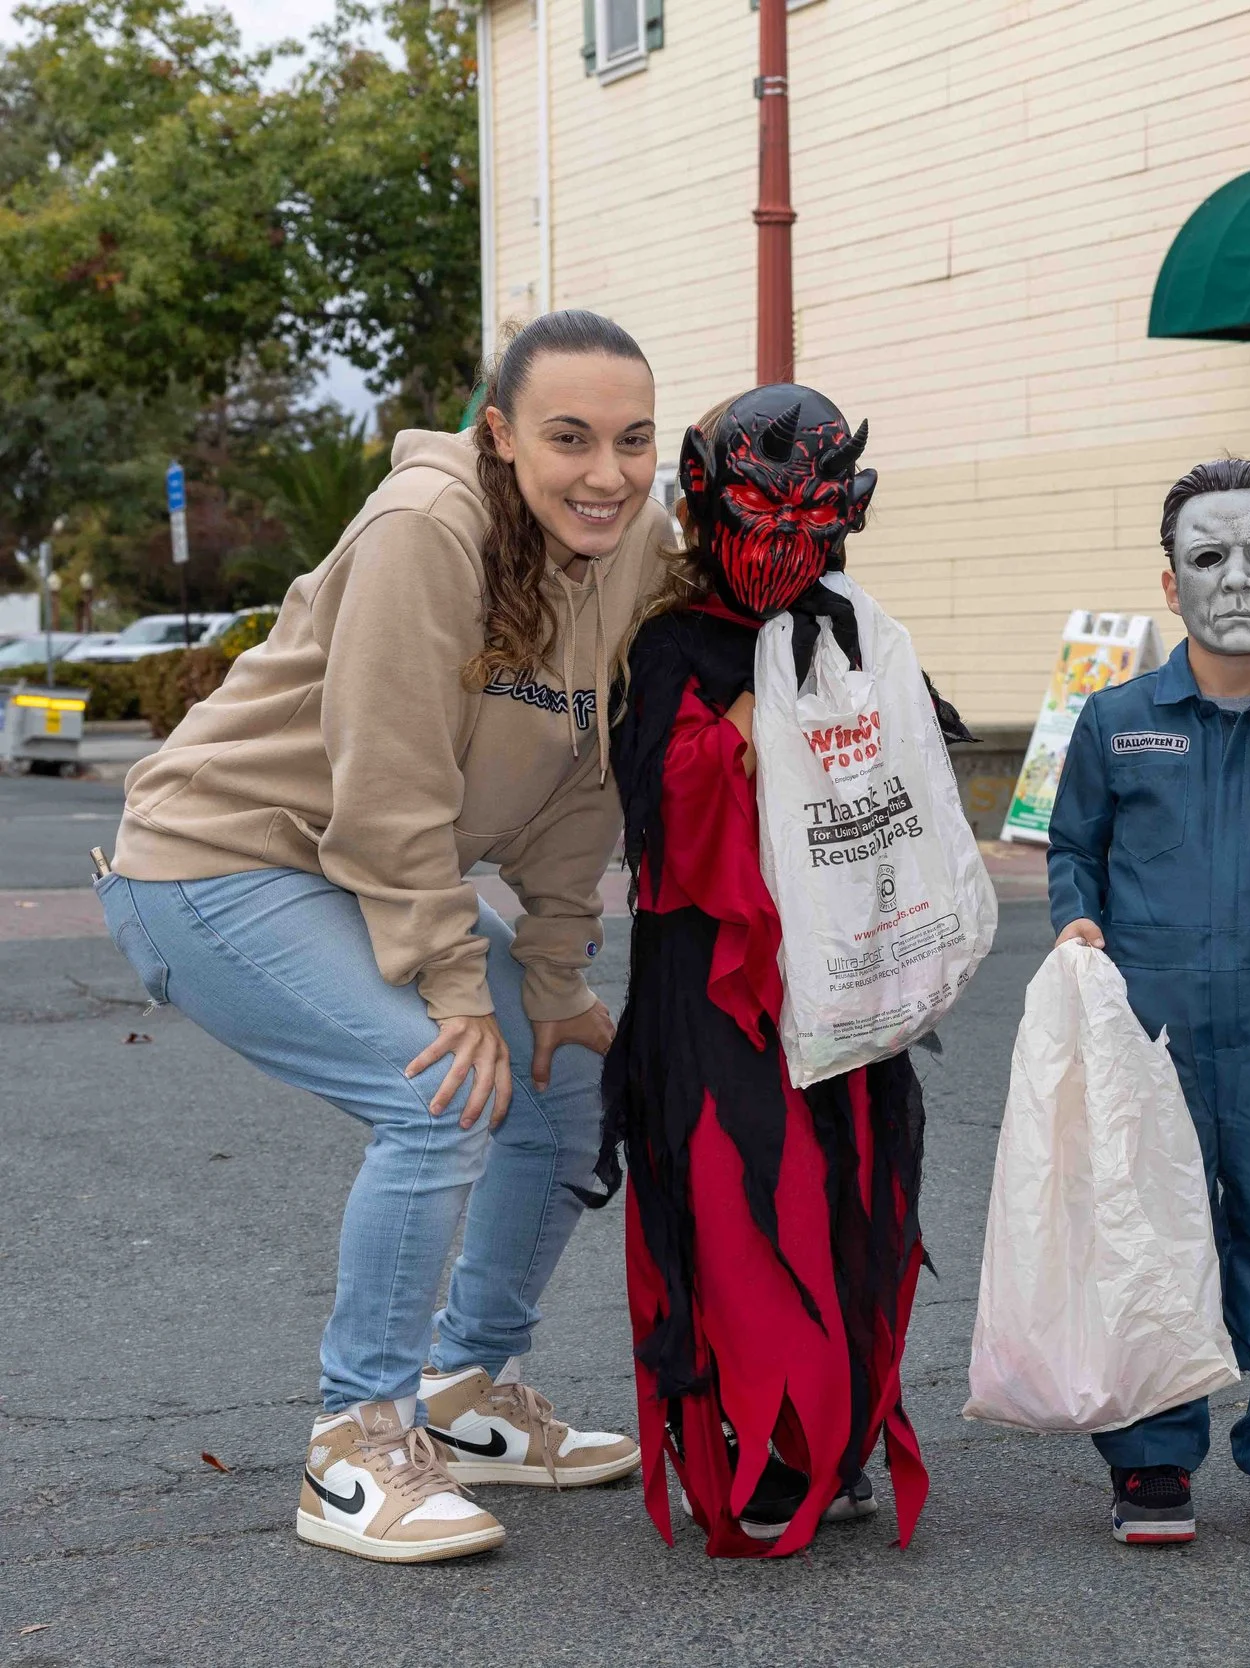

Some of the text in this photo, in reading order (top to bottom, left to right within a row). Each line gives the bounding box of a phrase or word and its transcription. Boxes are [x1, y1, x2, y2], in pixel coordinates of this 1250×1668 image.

[1117, 737, 1184, 749] HALLOWEEN II
[804, 786, 880, 825] Thank
[813, 831, 831, 841] for
[834, 826, 859, 839] Using
[889, 798, 907, 812] this
[893, 815, 923, 838] ag
[905, 941, 946, 967] PARTICIPATING
[946, 933, 967, 948] STORE
